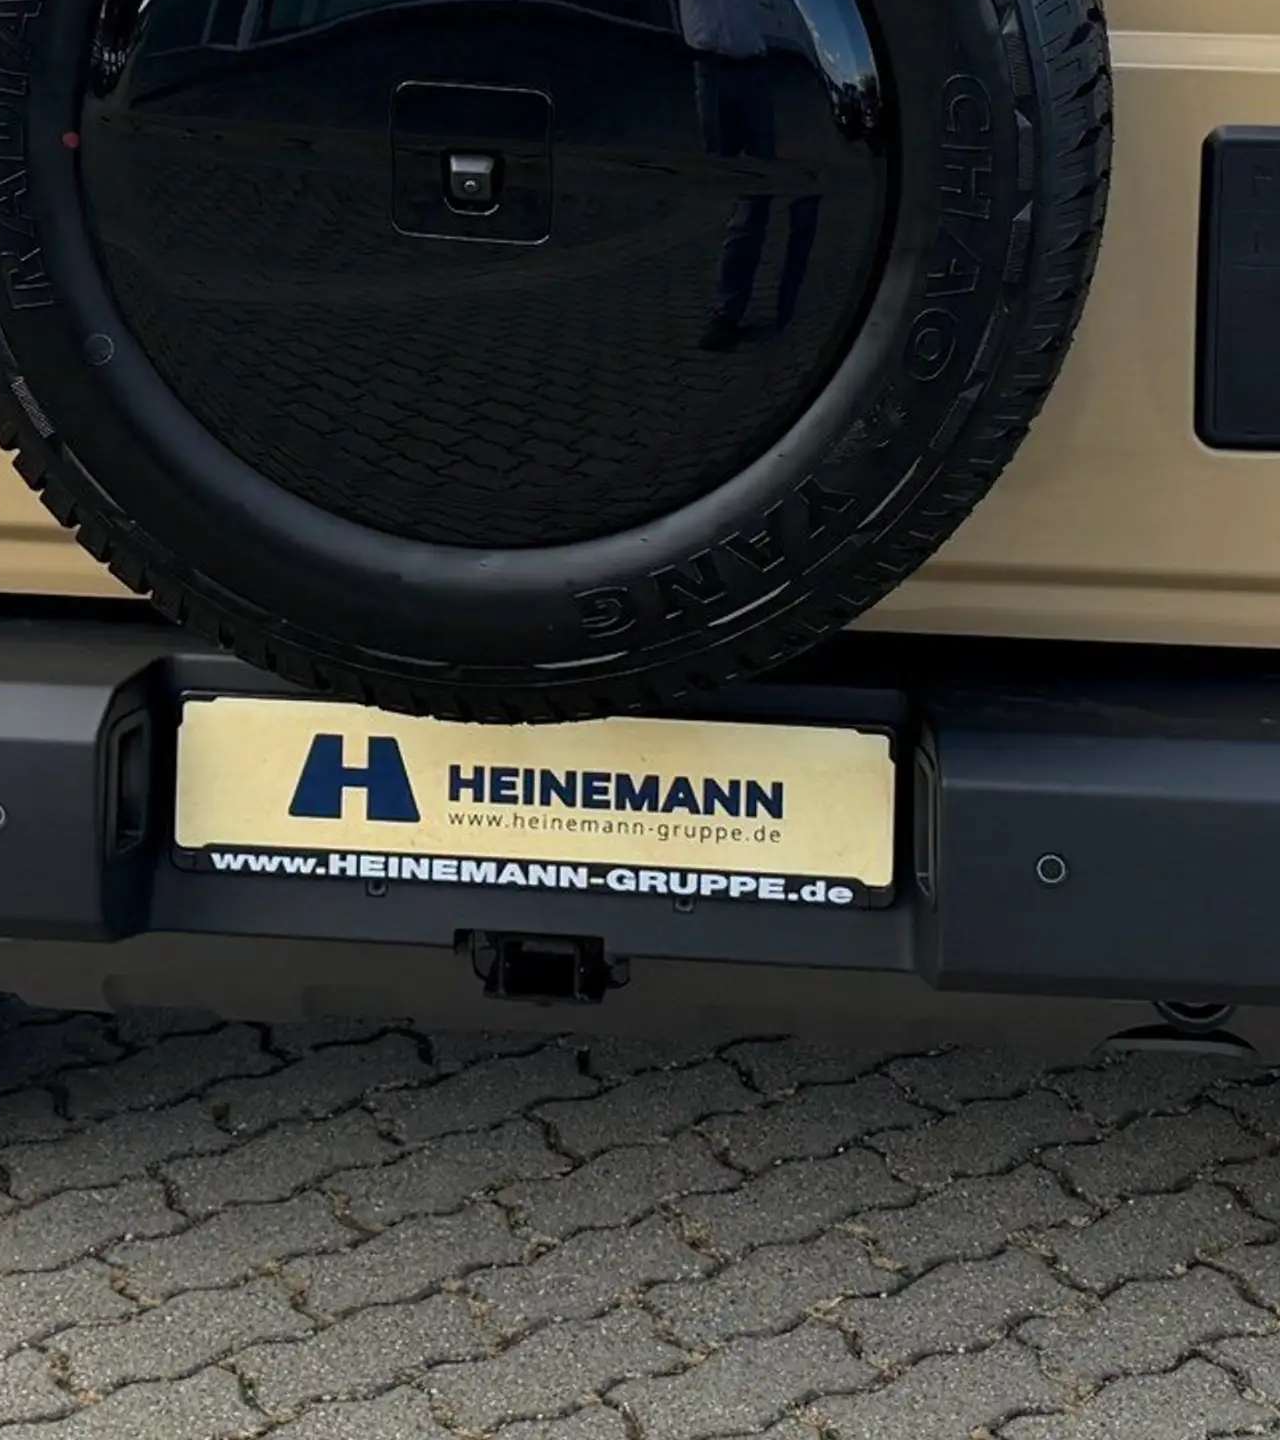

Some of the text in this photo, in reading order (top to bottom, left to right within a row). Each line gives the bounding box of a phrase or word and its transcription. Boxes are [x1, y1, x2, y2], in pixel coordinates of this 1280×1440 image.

[448, 763, 786, 820] HEINEMANN
[447, 810, 784, 845] www.heinemann-gruppe.de
[209, 851, 855, 907] www.HEINEMANN-GRUPPE.de
